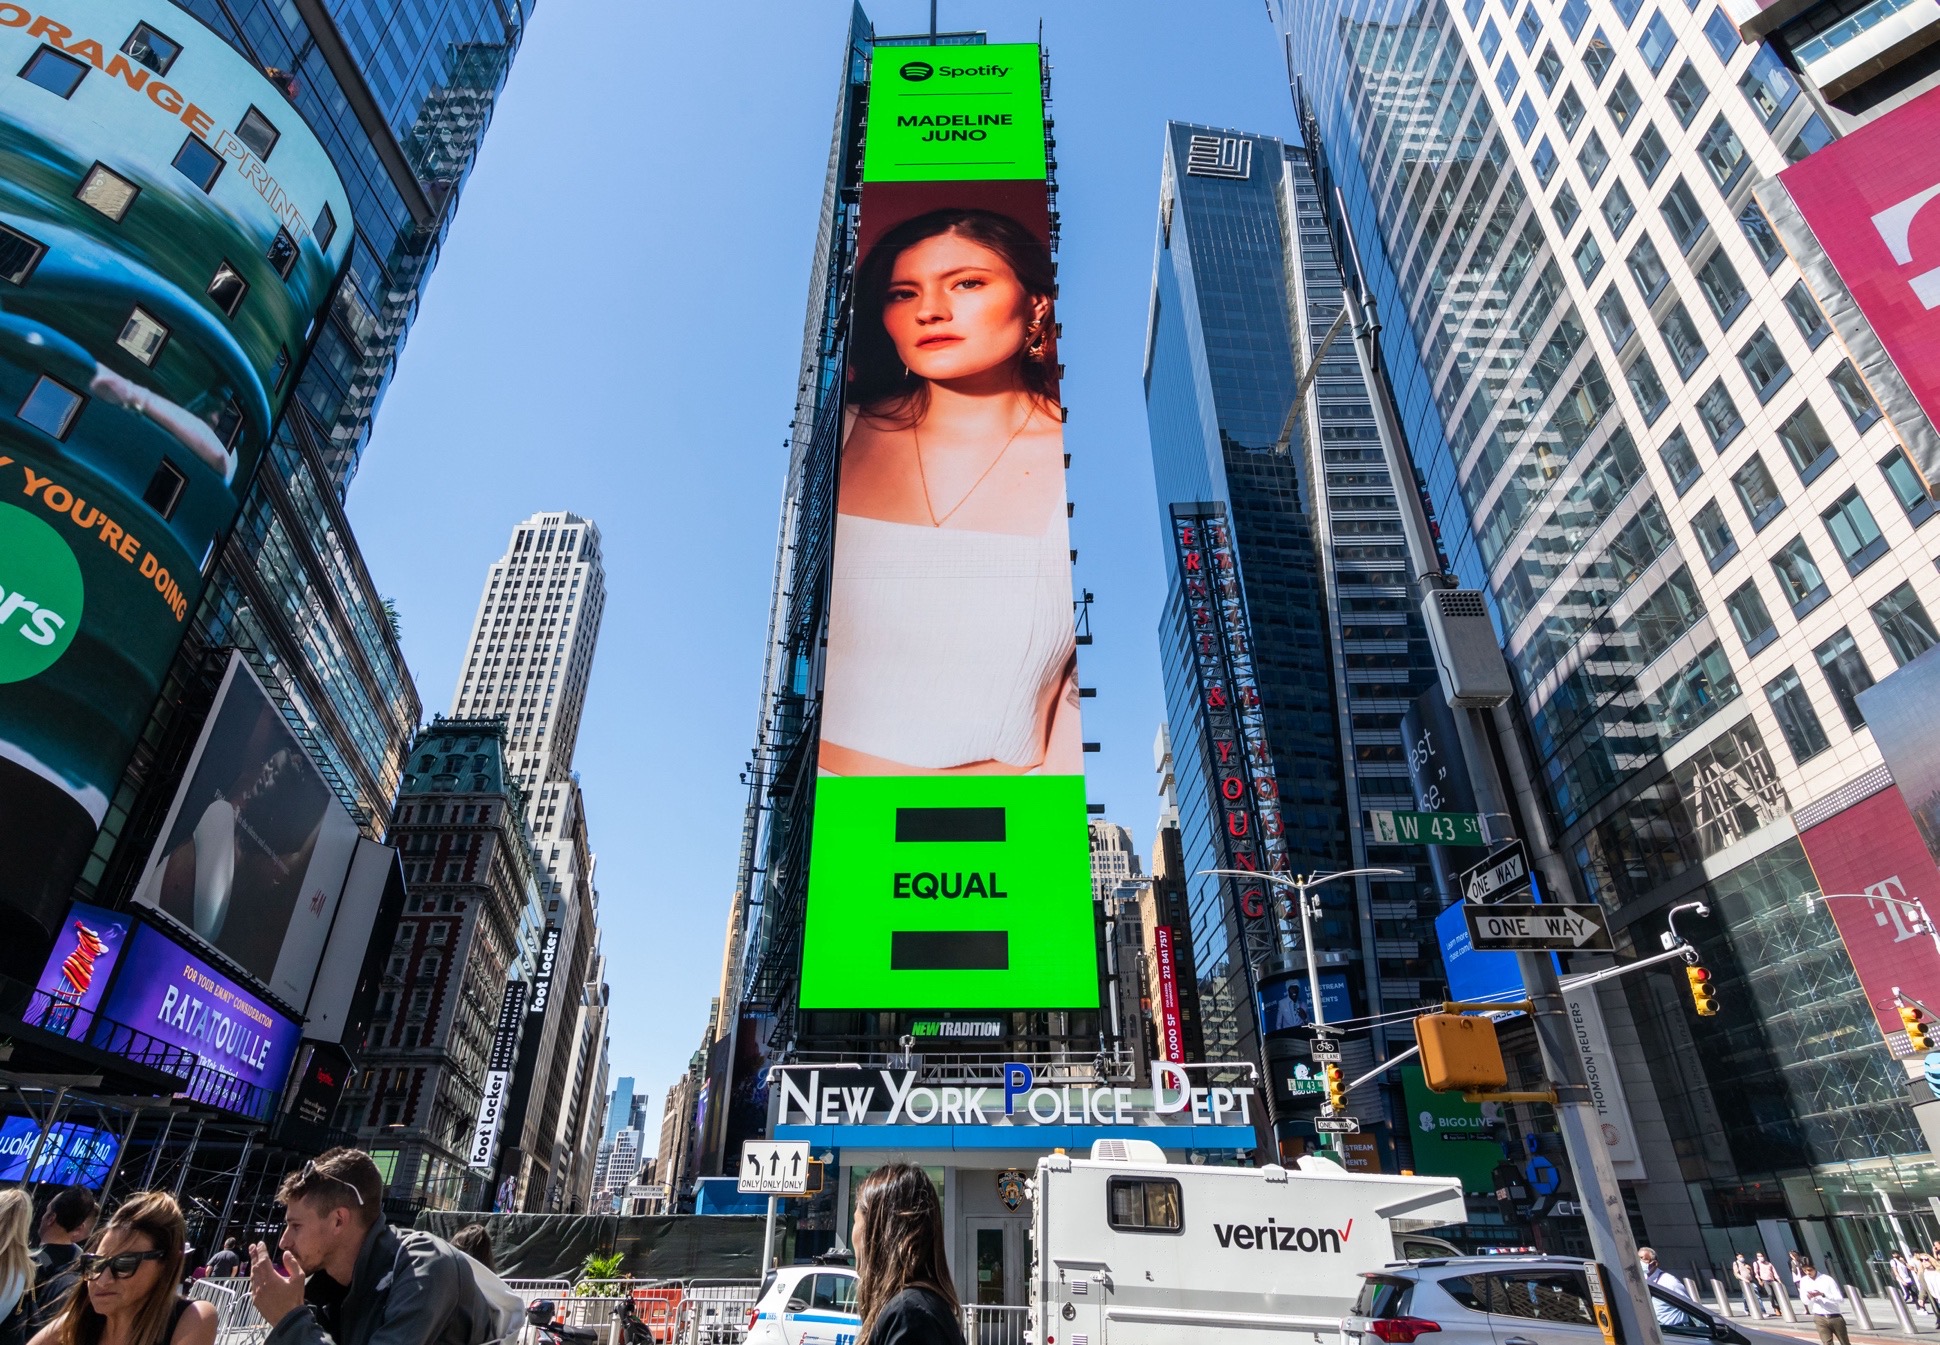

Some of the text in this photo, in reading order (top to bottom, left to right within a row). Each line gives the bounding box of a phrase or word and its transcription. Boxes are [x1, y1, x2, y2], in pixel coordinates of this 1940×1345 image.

[939, 65, 1009, 78] Spotify
[0, 3, 311, 243] ORANGE PRINT
[897, 114, 1013, 127] MADELINE
[921, 129, 987, 142] JUNO
[22, 466, 188, 622] YOU'RE DOING
[1208, 686, 1228, 707] &
[1215, 740, 1264, 919] YOUNG
[1399, 816, 1479, 841] W 43 St
[893, 872, 1008, 900] EQUAL
[1471, 858, 1518, 898] ONE WAY
[1488, 918, 1585, 936] ONE WAY
[1159, 930, 1171, 979] 212 841 7517
[183, 965, 198, 983] FOR
[198, 973, 215, 993] YOUR
[233, 997, 274, 1029] CONSIDERATION
[530, 981, 549, 1012] Foot
[157, 984, 272, 1071] RATATOUILLE
[1167, 1013, 1179, 1059] 9,000 SF
[1569, 1002, 1608, 1116] THOMSON REUTERS
[481, 1075, 504, 1124] Locker
[777, 1060, 1255, 1126] NEW YORK POLICE DEPT
[1296, 1081, 1304, 1089] W
[1307, 1081, 1316, 1090] 43
[1320, 1120, 1353, 1129] ONE WAY
[1439, 1117, 1494, 1127] BIGO LIVE
[473, 1130, 491, 1162] Foot
[741, 1180, 803, 1189] ONLY ONLY ONLY
[1213, 1218, 1341, 1253] verizon
